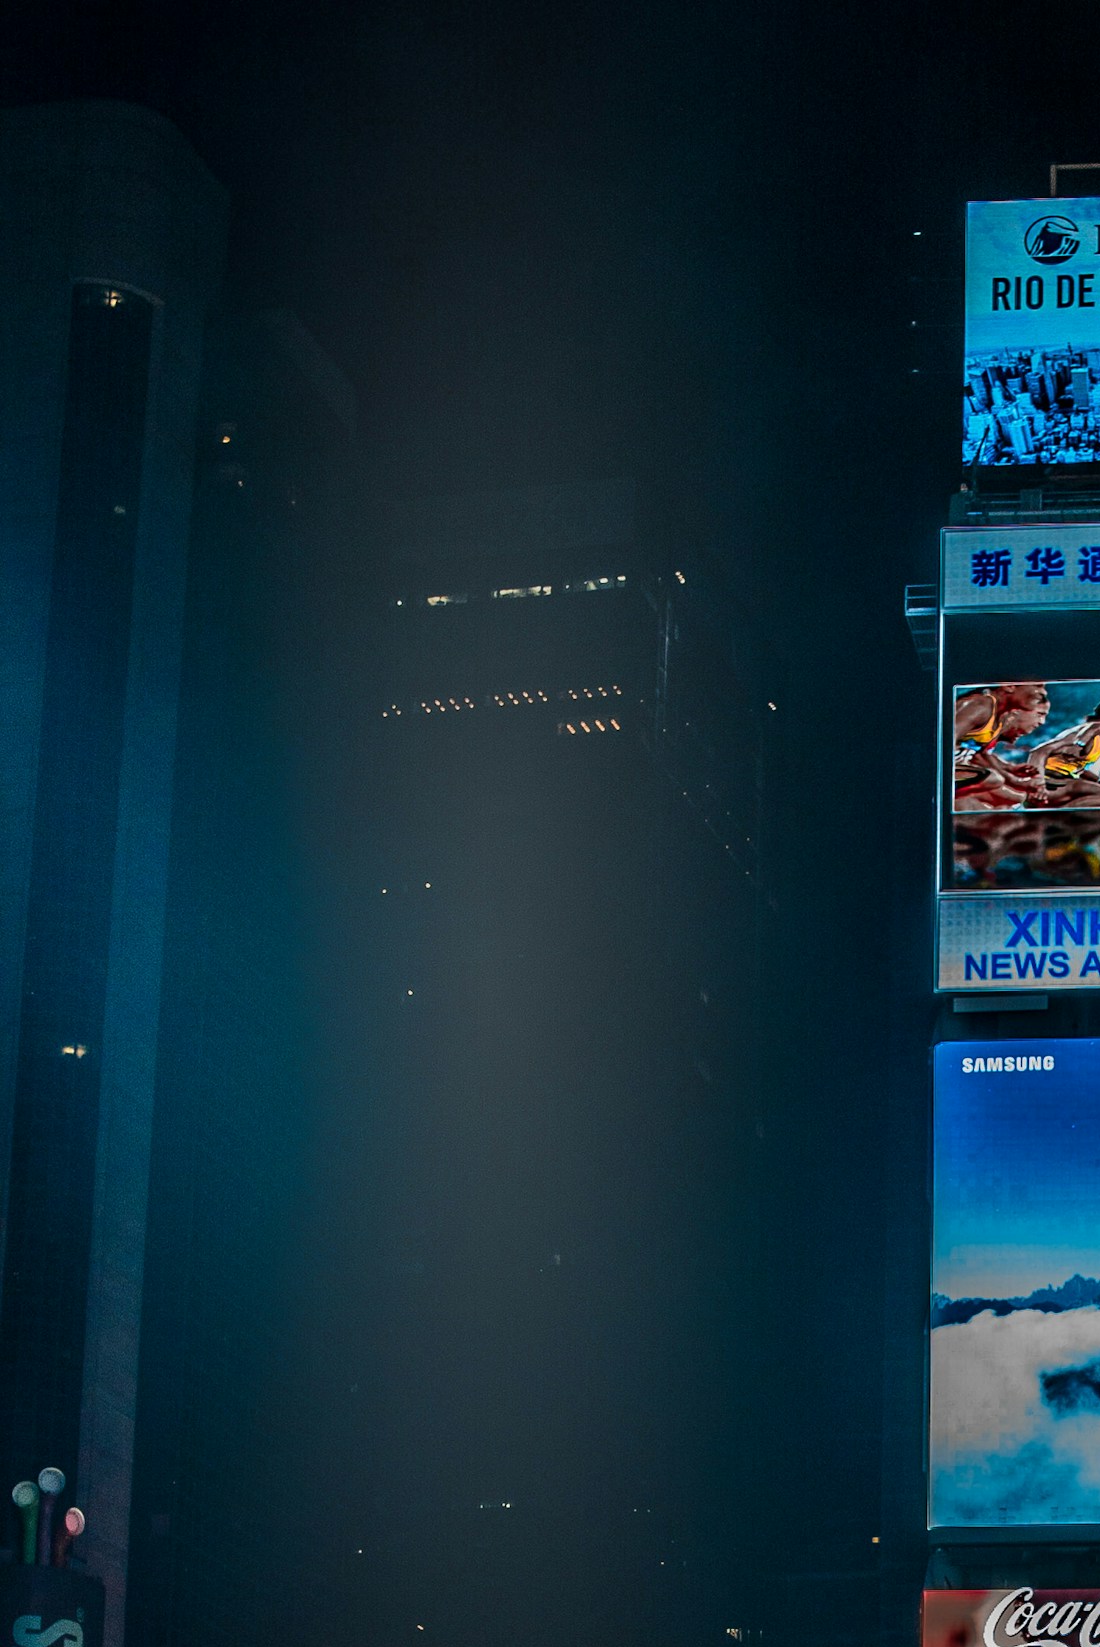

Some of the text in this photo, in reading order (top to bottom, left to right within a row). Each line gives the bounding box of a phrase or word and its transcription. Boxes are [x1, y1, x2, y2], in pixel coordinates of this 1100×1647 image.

[991, 275, 1044, 311] RIO
[1056, 273, 1095, 309] DE
[964, 951, 1071, 981] NEWS
[962, 1055, 1055, 1074] SAMSUNG
